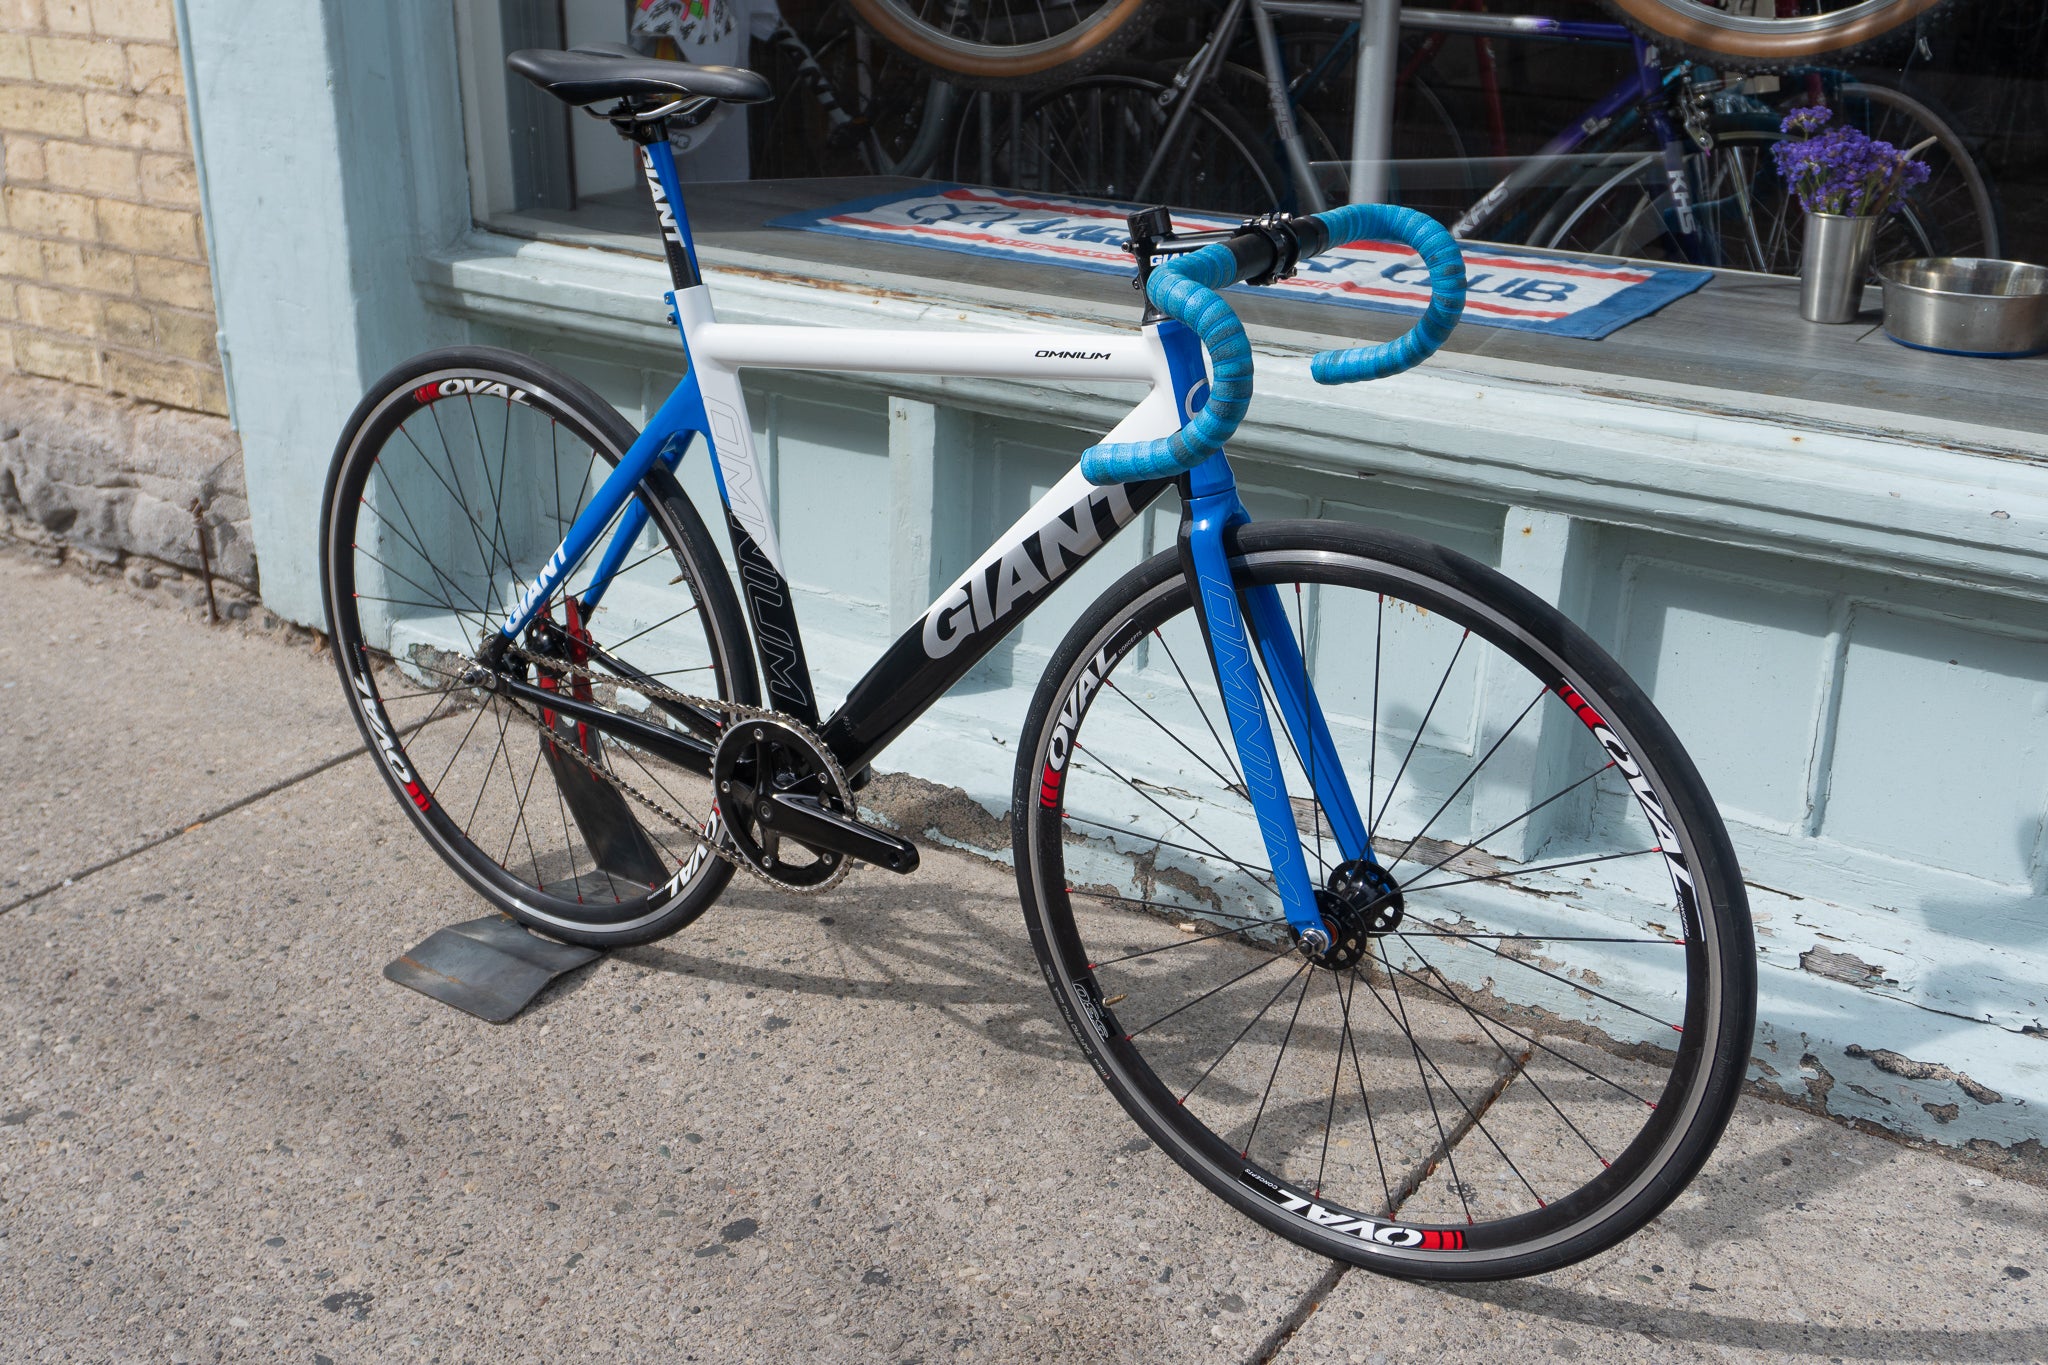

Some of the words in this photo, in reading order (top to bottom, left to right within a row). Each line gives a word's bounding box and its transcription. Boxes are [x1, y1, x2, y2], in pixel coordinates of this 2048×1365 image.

[640, 145, 687, 248] GIANT
[1451, 180, 1509, 239] KHS
[1668, 169, 1697, 235] KHS
[438, 378, 531, 406] OVAL
[1034, 350, 1112, 361] OMNIUM
[504, 535, 568, 634] GIANT
[702, 396, 808, 707] OMNIUM
[922, 482, 1137, 660] GIANT
[354, 672, 413, 784] OVAL
[1050, 648, 1118, 771] OVAL
[1118, 630, 1143, 654] CONCEPTS
[1200, 575, 1301, 907] OMNIUM
[664, 809, 719, 898] OVAL
[1594, 727, 1693, 895] OVAL
[1677, 894, 1690, 937] CONCEPTS
[1244, 1167, 1279, 1191] CONCEPTS
[1277, 1188, 1423, 1248] OVAL
